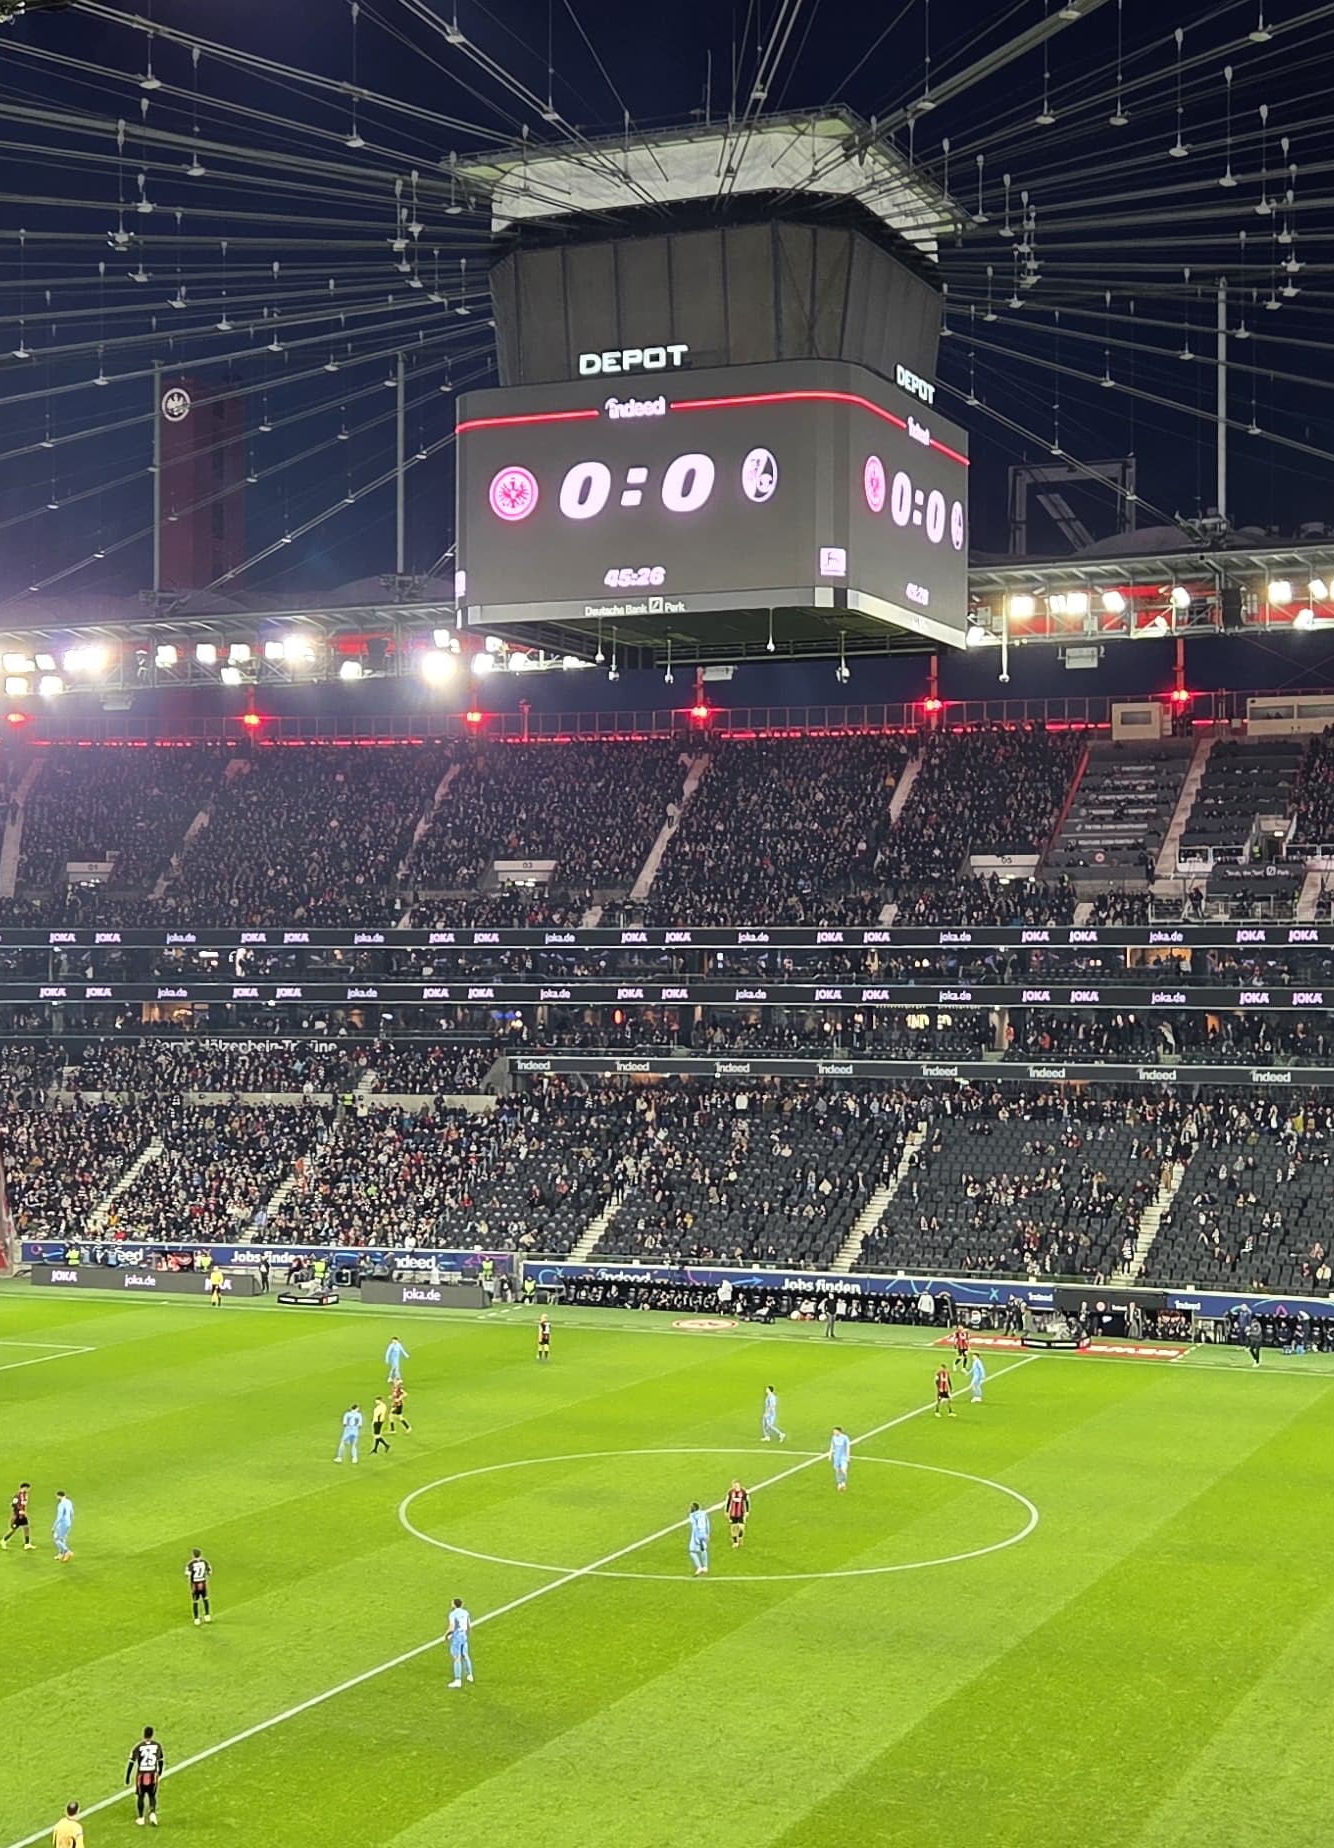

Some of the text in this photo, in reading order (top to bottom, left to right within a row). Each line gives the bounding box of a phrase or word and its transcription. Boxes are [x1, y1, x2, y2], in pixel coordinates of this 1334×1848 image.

[579, 344, 689, 375] DEPOT
[896, 364, 935, 404] DEPOT
[604, 396, 665, 418] indeed
[604, 566, 666, 587] 45:26
[584, 601, 685, 617] Deutsche Bank Park
[49, 933, 76, 943] JOKA
[95, 933, 121, 943] JOKA
[241, 933, 266, 943] JOKA
[284, 933, 309, 943] JOKA
[429, 933, 455, 943] JOKA
[474, 933, 499, 943] JOKA
[621, 933, 647, 943] JOKA
[665, 932, 691, 944] JOKA
[817, 932, 843, 943] JOKA
[864, 932, 890, 943] JOKA
[1022, 931, 1049, 942] JOKA
[1069, 931, 1097, 942] JOKA
[1237, 930, 1265, 942] JOKA
[1289, 930, 1318, 942] JOKA
[40, 988, 66, 997] JOKA
[86, 988, 112, 998] JOKA
[233, 988, 258, 998] JOKA
[276, 988, 302, 999] JOKA
[423, 988, 449, 998] JOKA
[468, 988, 494, 999] JOKA
[617, 989, 643, 999] JOKA
[662, 989, 688, 999] JOKA
[815, 990, 842, 1000] JOKA
[862, 990, 889, 1001] JOKA
[1022, 991, 1050, 1002] JOKA
[1070, 991, 1099, 1002] JOKA
[1240, 993, 1269, 1004] JOKA
[1293, 993, 1322, 1005] JOKA
[517, 1060, 551, 1071] indeed
[616, 1061, 650, 1072] indeed
[715, 1062, 750, 1073] indeed
[817, 1063, 853, 1075] indeed
[921, 1065, 958, 1076] indeed
[1027, 1066, 1066, 1079] indeed
[1138, 1068, 1177, 1081] indeed
[1250, 1071, 1291, 1083] indeed
[230, 1251, 260, 1263] Jobs
[51, 1270, 156, 1287] JOKA joka.de
[782, 1278, 861, 1294] Jobs finden
[403, 1287, 441, 1302] joka.de
[140, 1748, 157, 1767] 25
